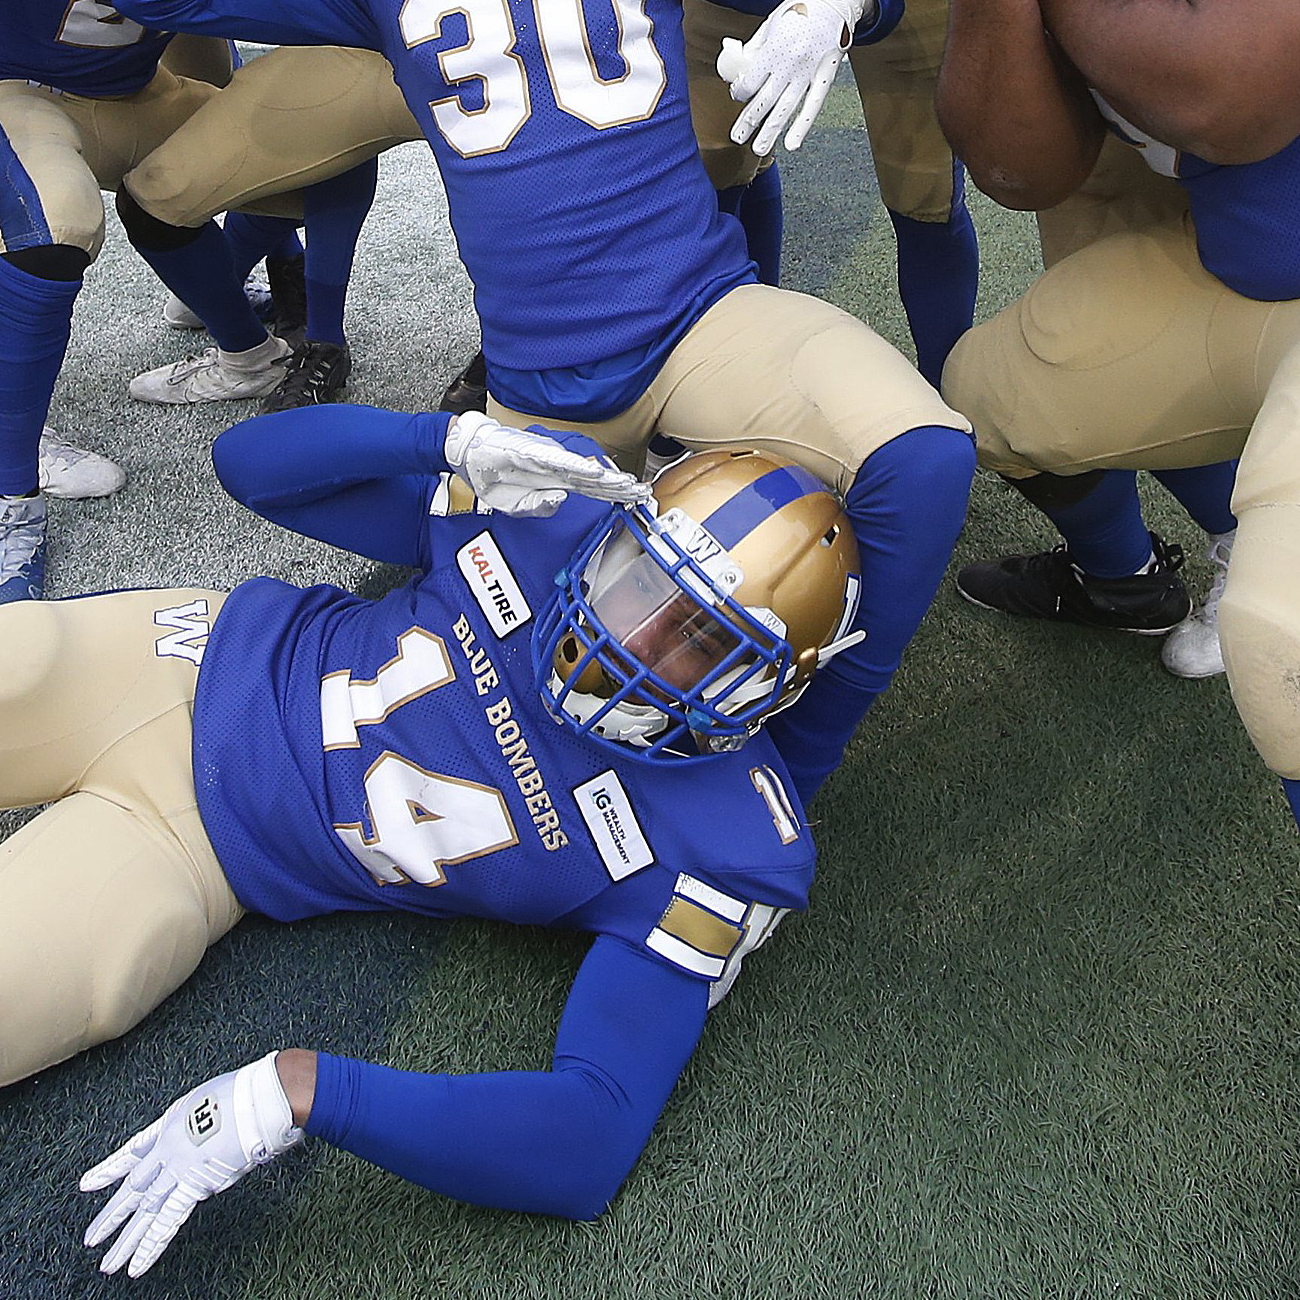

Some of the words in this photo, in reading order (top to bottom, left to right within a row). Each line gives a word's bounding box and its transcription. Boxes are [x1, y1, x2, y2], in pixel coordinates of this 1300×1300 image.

[686, 530, 722, 563] W
[154, 598, 211, 667] W
[452, 613, 499, 696] BLUE
[485, 696, 569, 852] BOMBERS
[320, 626, 520, 888] 14
[592, 787, 612, 810] IG
[602, 811, 631, 865] MANAGEMENT
[609, 807, 627, 841] WEALTH
[194, 1097, 214, 1135] CFL
